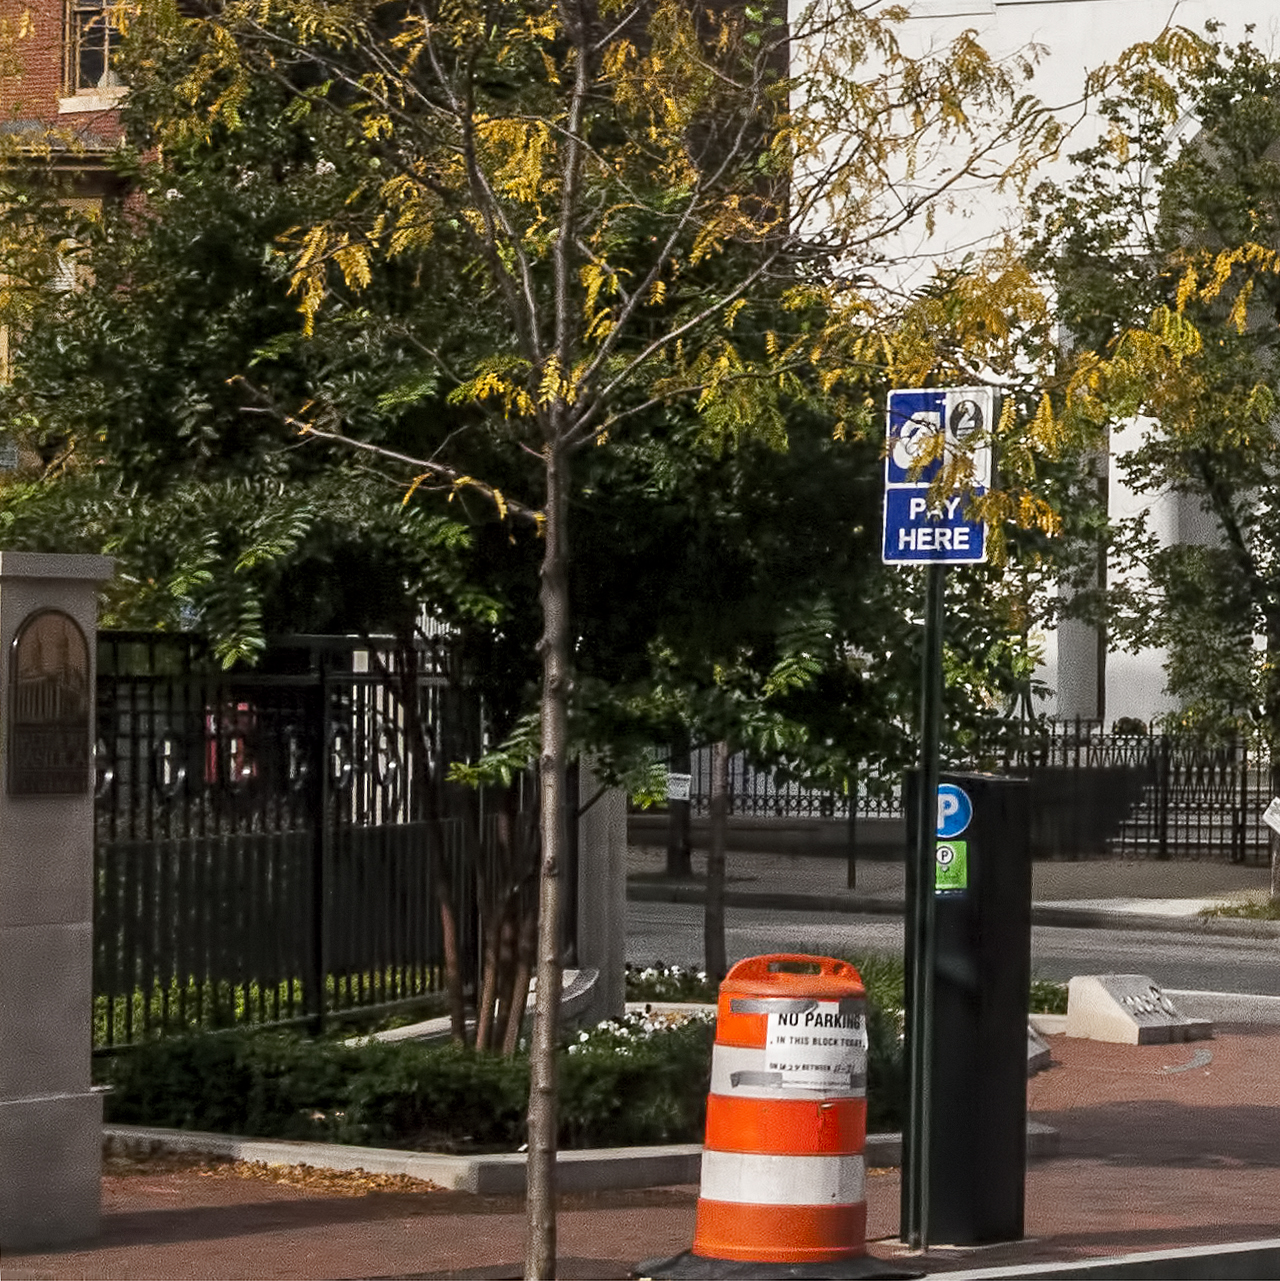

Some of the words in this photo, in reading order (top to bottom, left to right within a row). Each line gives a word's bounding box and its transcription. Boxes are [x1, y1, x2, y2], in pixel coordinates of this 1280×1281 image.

[899, 527, 970, 550] HERE
[778, 1013, 799, 1027] NO
[805, 1012, 861, 1030] PARKING
[777, 1036, 786, 1044] IN
[789, 1036, 810, 1046] THIS
[813, 1037, 838, 1047] BLOCK
